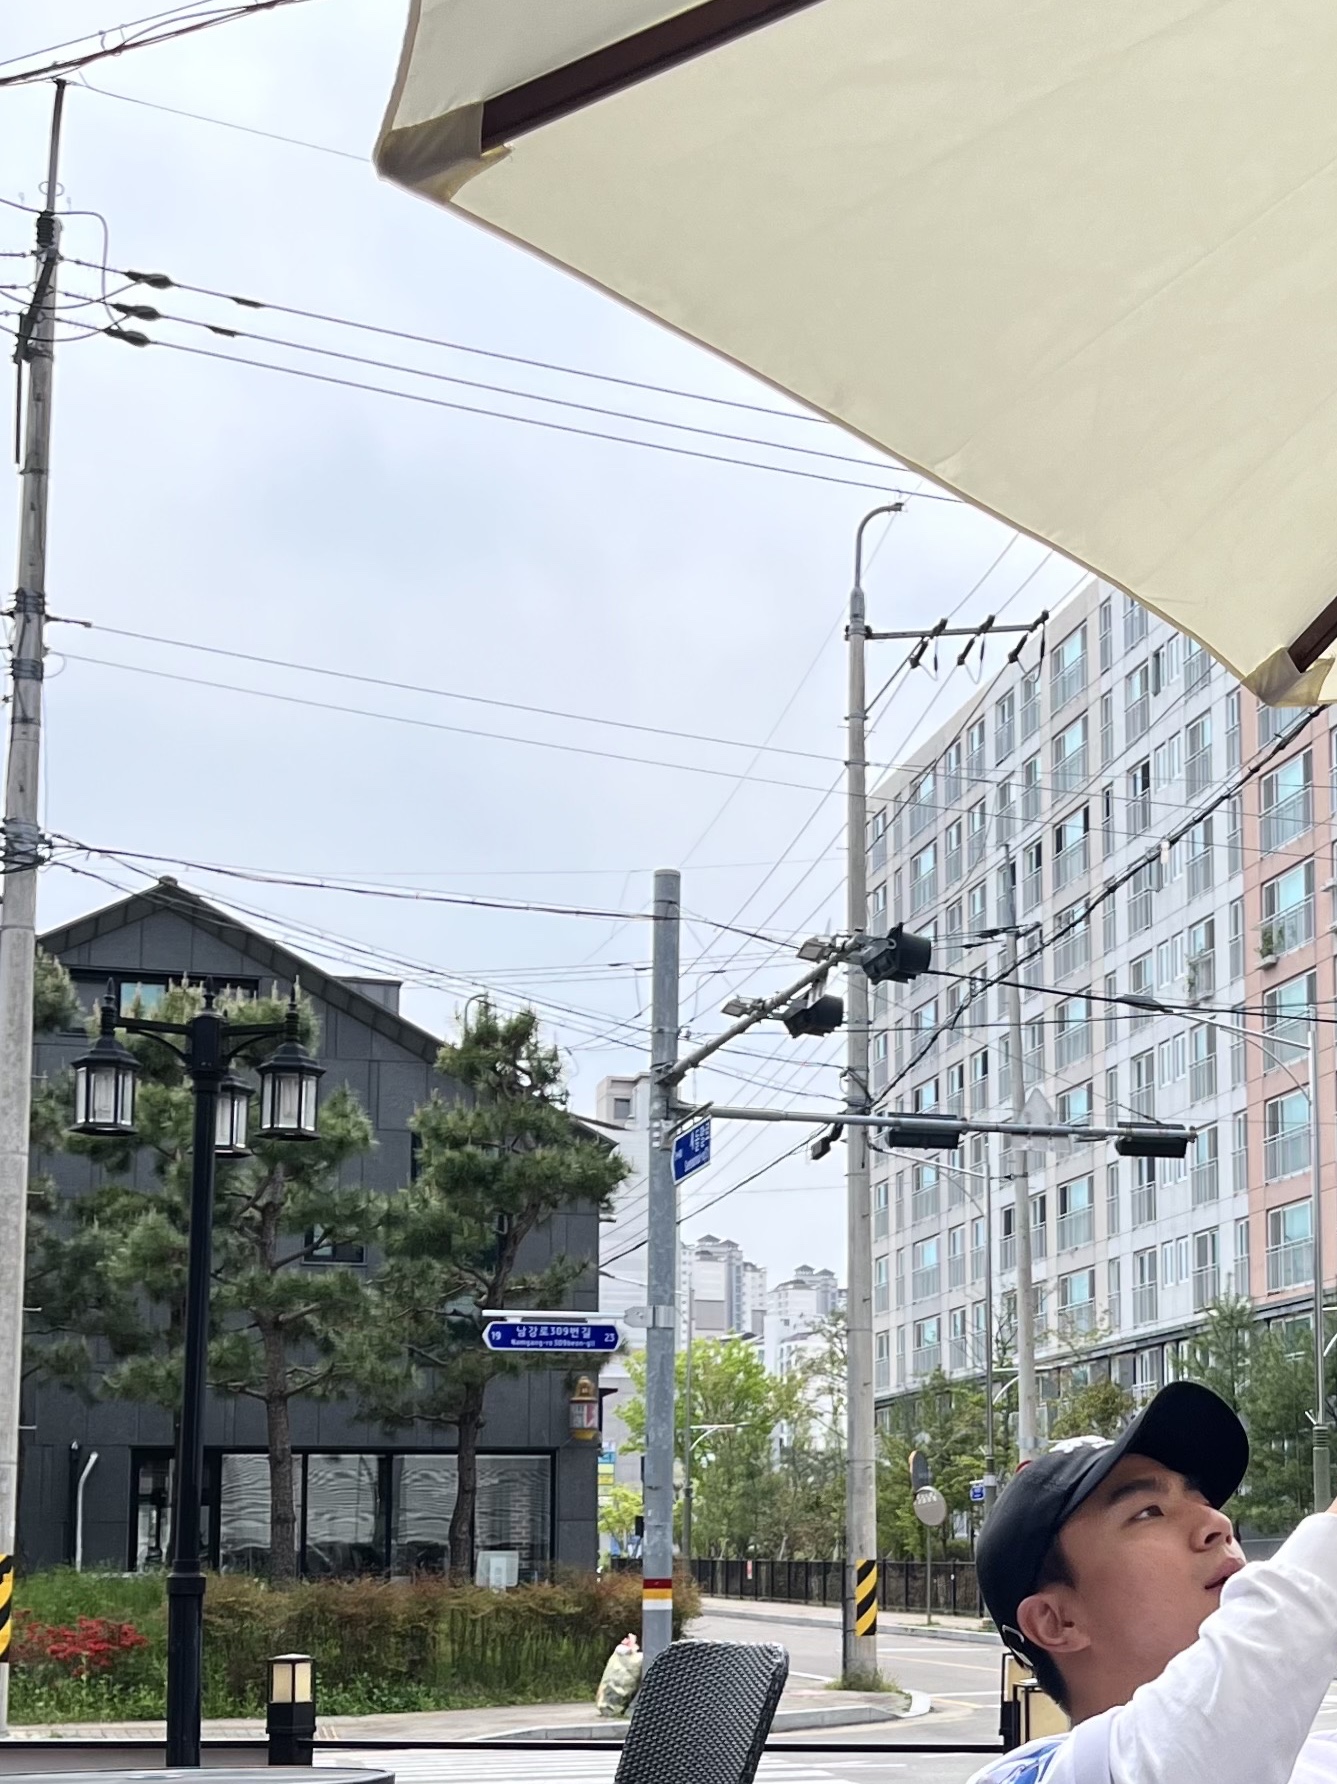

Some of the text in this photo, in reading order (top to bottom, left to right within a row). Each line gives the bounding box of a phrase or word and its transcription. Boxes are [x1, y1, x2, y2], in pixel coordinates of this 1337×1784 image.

[491, 1331, 501, 1340] 19
[516, 1326, 591, 1339] 남강로309번길
[604, 1333, 615, 1342] 23
